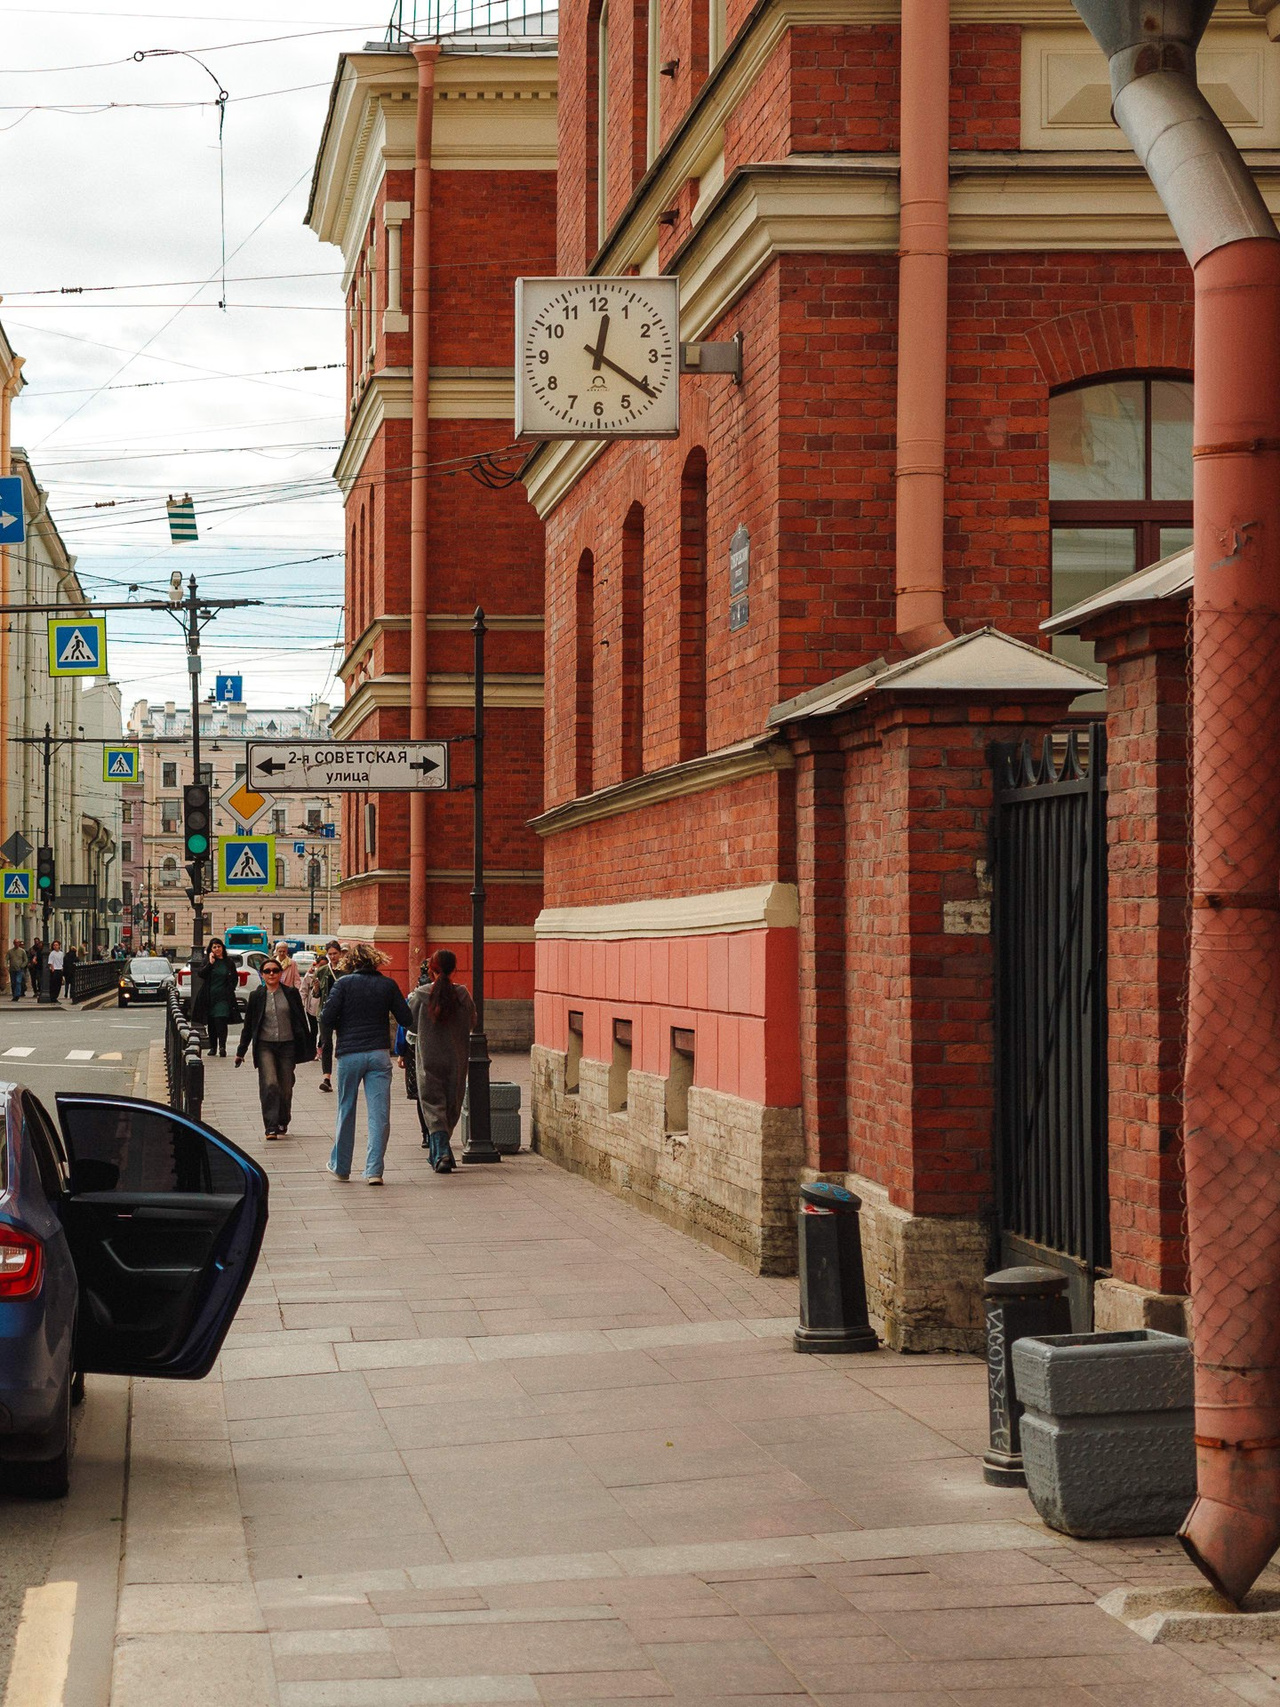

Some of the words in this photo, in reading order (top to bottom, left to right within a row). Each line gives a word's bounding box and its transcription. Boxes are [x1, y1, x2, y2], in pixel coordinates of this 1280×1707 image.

[589, 297, 608, 312] 12
[562, 305, 578, 320] 11
[621, 305, 629, 319] 1
[545, 324, 564, 339] 10
[640, 323, 651, 338] 2
[539, 350, 549, 364] 9
[648, 349, 659, 364] 3
[547, 376, 558, 390] 8
[640, 375, 650, 389] 4
[568, 395, 578, 409] 7
[593, 401, 604, 416] 6
[620, 394, 631, 409] 5
[288, 751, 310, 764] 2-я
[314, 751, 408, 764] СОВЕТСКАЯ
[326, 771, 369, 785] улица
